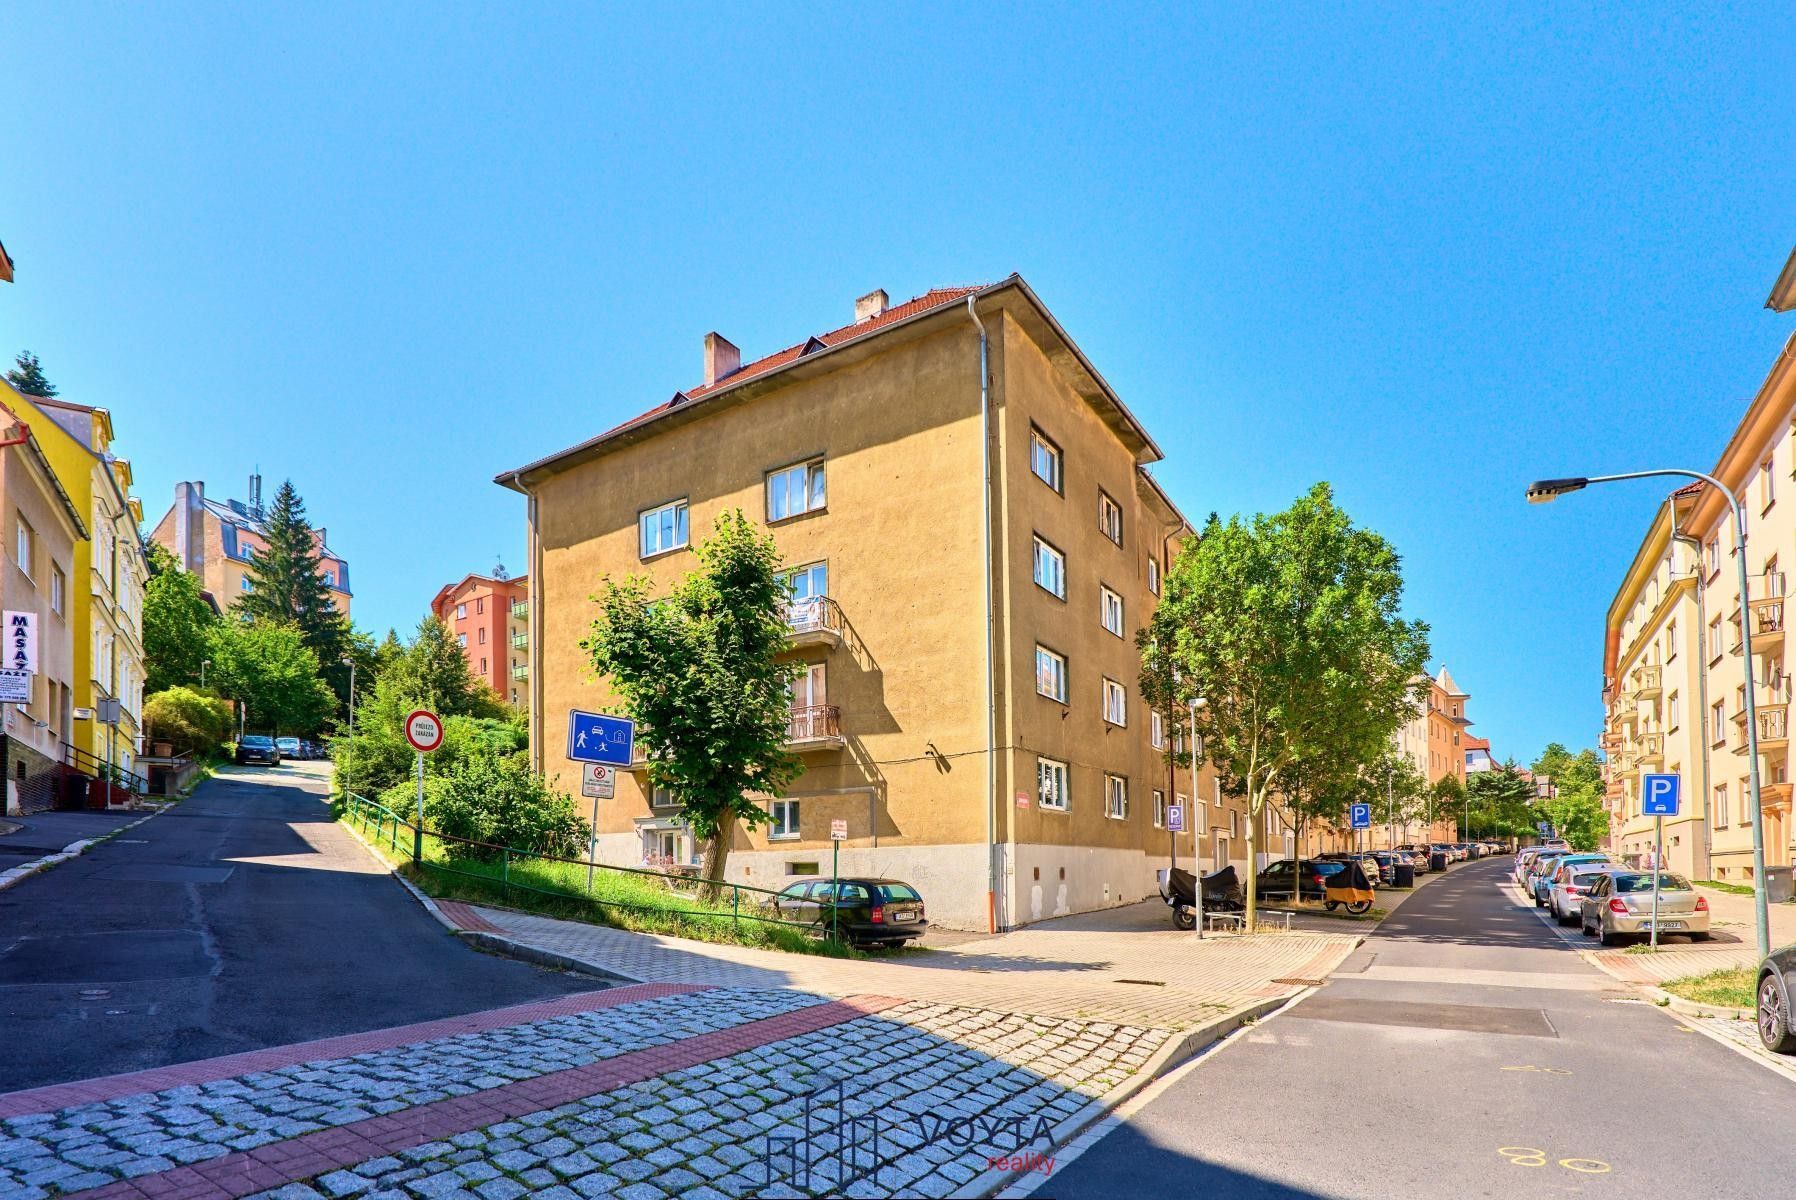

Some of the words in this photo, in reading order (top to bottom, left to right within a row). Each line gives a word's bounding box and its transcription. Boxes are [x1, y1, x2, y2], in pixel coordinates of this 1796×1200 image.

[1651, 779, 1671, 802] P
[1170, 809, 1180, 823] P
[1355, 807, 1366, 821] P
